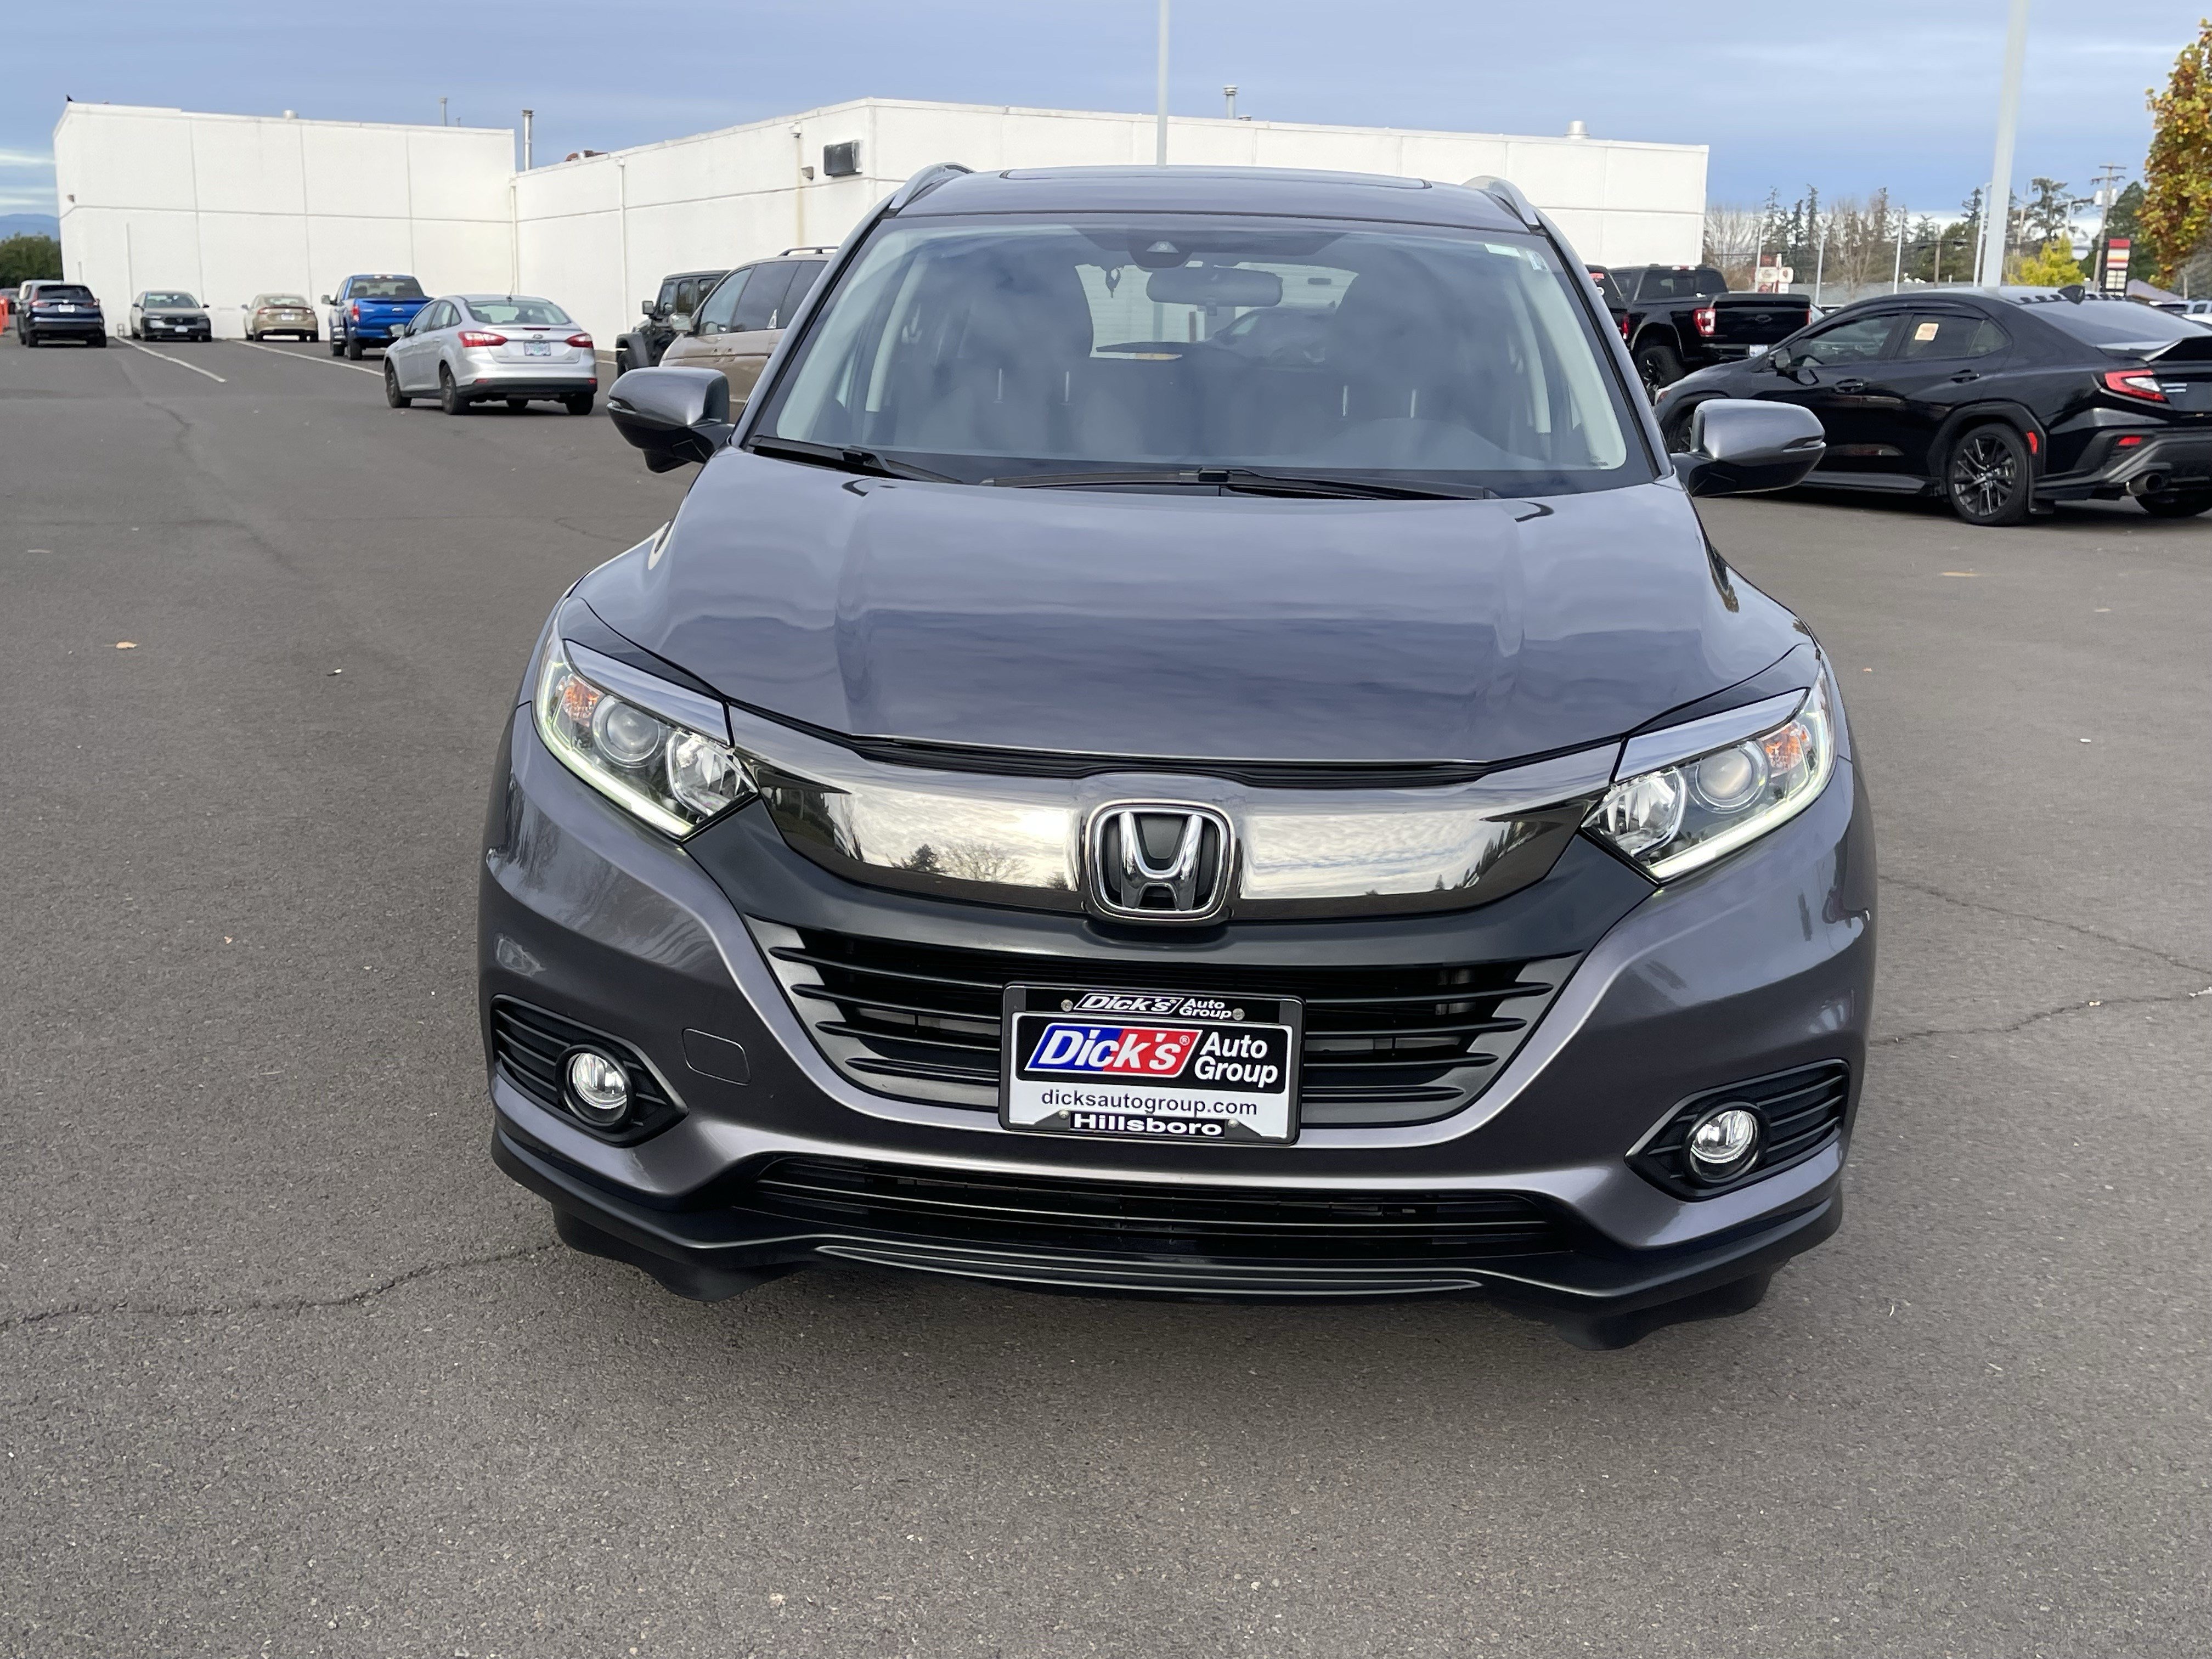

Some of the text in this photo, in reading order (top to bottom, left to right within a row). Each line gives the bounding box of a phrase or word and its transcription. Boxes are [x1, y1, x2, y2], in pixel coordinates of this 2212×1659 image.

[1179, 1007, 1232, 1019] Group
[1183, 998, 1226, 1009] Auto
[1199, 1031, 1268, 1059] Auto
[1194, 1056, 1279, 1088] Group
[1041, 1088, 1258, 1118] dicksautogroup.com
[1073, 1113, 1222, 1136] Hillsboro
